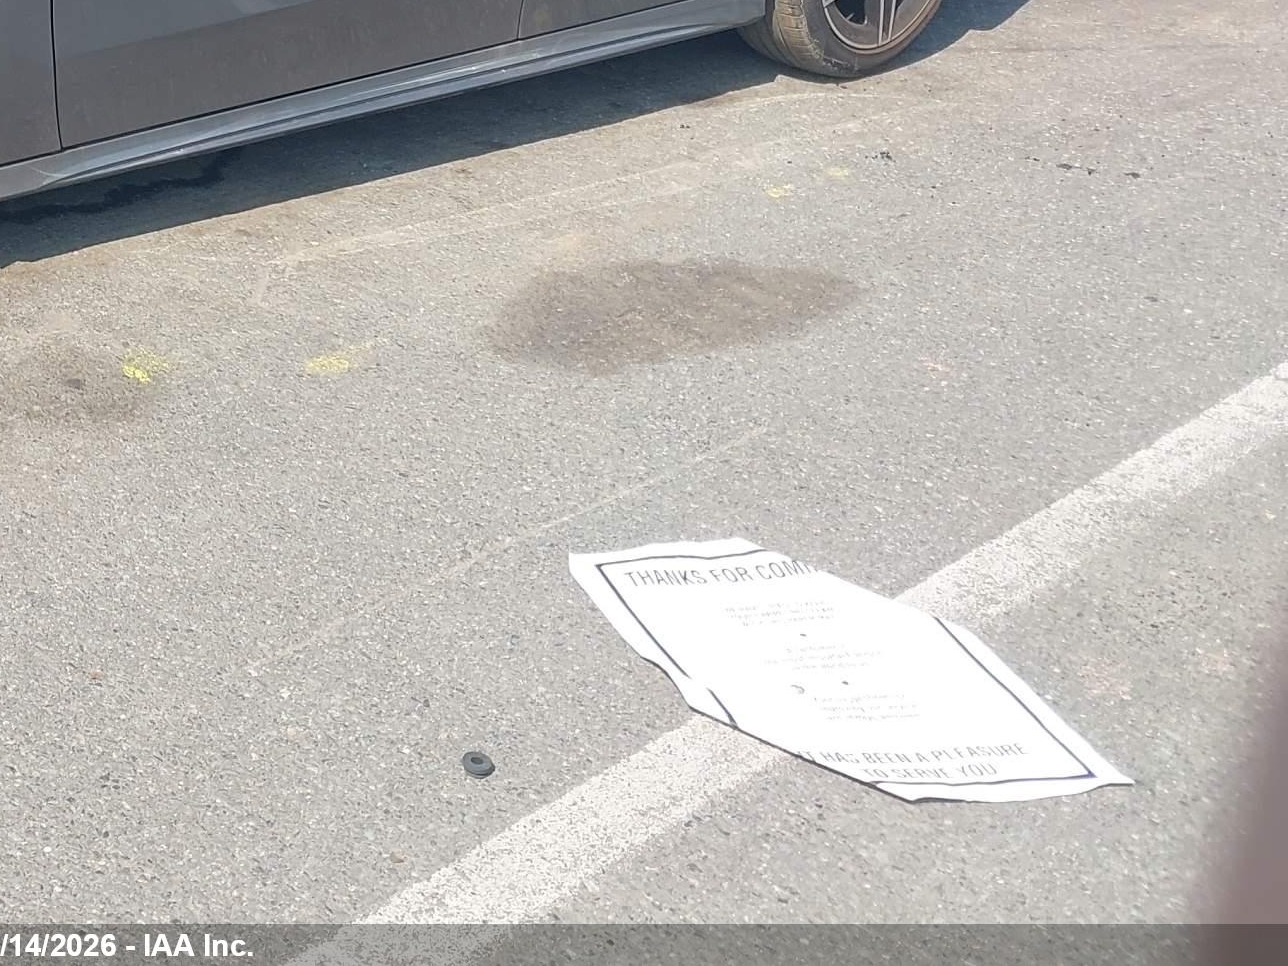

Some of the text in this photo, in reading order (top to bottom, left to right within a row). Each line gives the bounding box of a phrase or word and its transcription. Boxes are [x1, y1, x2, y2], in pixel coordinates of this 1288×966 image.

[624, 569, 708, 587] THANKS
[709, 566, 754, 583] FOR
[861, 752, 912, 764] BEEN
[915, 751, 930, 763] A
[930, 742, 1029, 762] PLEASURE
[860, 762, 998, 779] TO SERVE YOU
